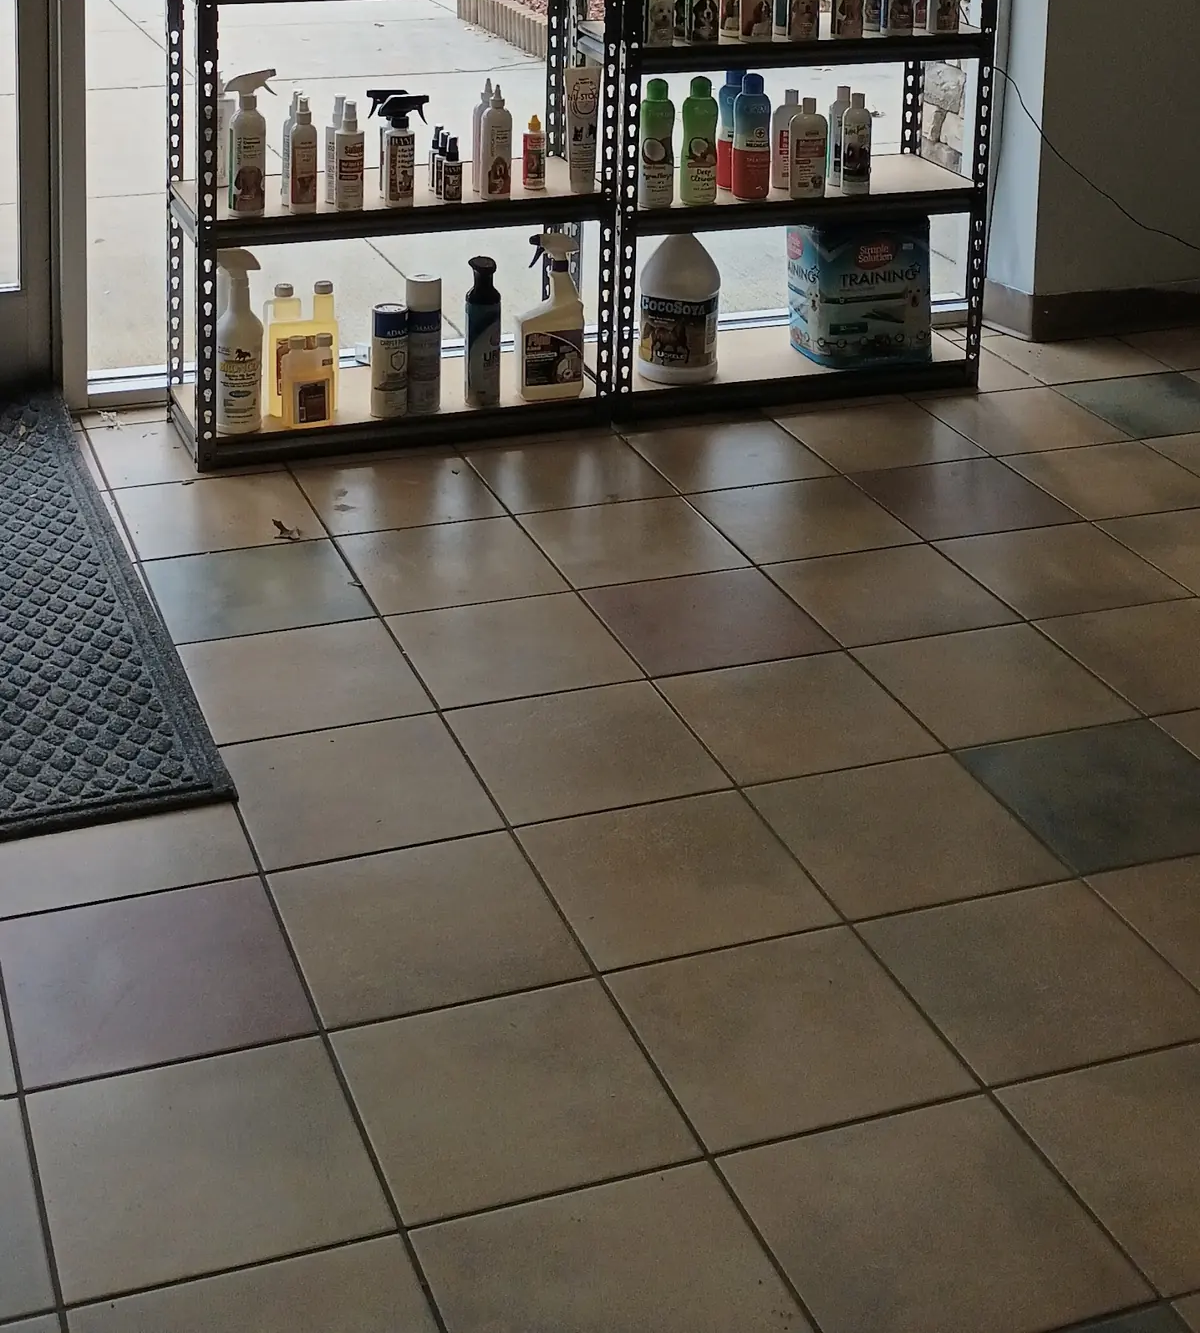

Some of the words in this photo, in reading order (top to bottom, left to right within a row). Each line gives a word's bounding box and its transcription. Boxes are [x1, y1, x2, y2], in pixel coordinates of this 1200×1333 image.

[859, 243, 889, 255] Simple
[858, 252, 893, 264] Solution
[839, 268, 917, 287] TRAINING
